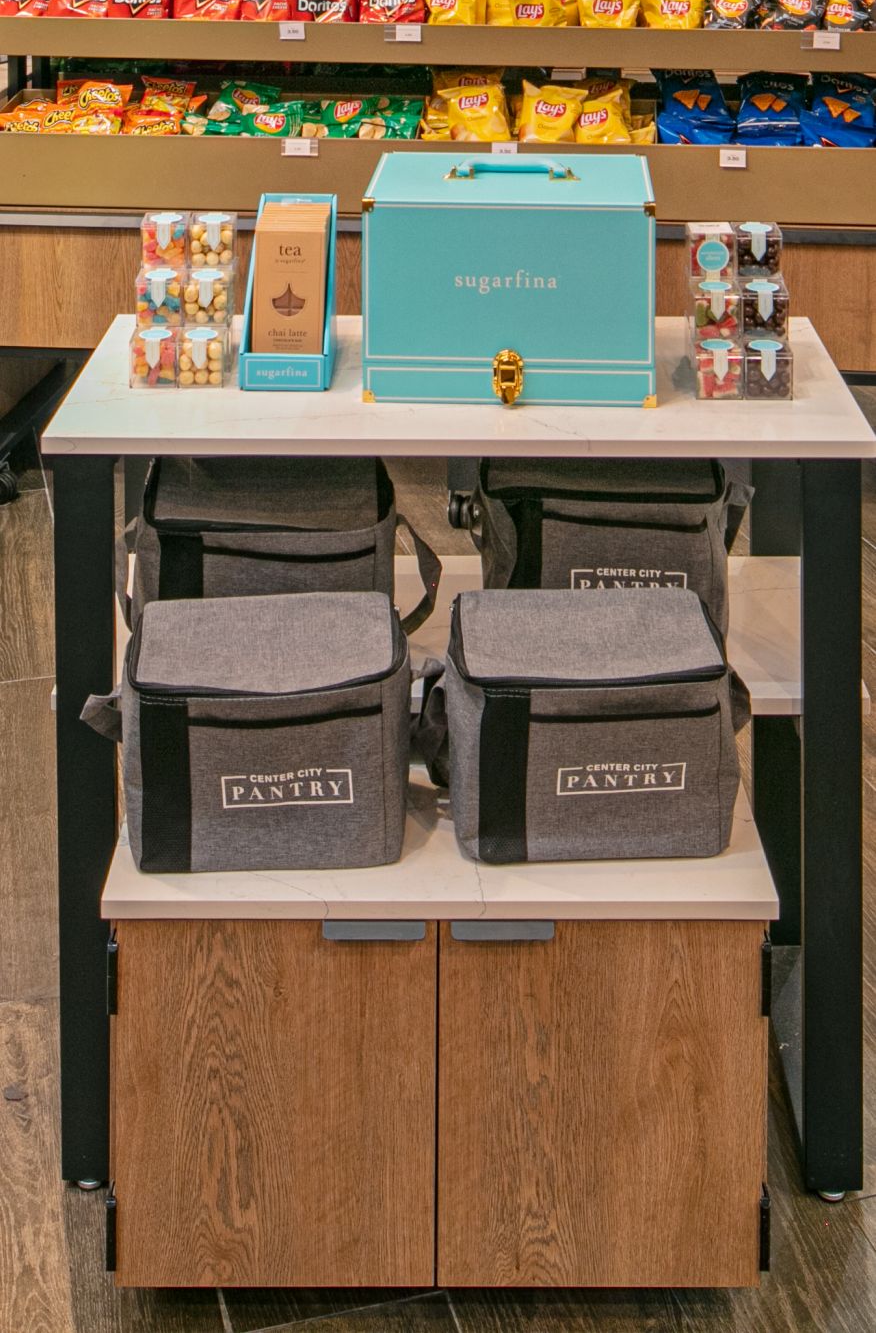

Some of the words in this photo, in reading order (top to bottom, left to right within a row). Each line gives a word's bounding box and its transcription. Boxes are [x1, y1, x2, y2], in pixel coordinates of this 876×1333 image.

[517, 4, 543, 20] Lay's
[662, 0, 690, 15] Lay's
[717, 0, 746, 11] Lay's
[79, 87, 122, 109] Cheetos
[460, 93, 488, 110] Lay's
[335, 100, 362, 116] Lay's
[536, 99, 566, 117] Lay's
[44, 111, 74, 127] Chee
[579, 109, 608, 126] Lay's
[279, 243, 302, 257] tea
[454, 270, 558, 294] sugarfina
[268, 328, 287, 338] chai
[289, 328, 308, 338] latte
[256, 366, 308, 379] sugarfina
[596, 568, 636, 577] CENTER
[639, 569, 662, 578] CITY
[249, 772, 294, 784] CENTER
[297, 767, 322, 778] CITY
[586, 763, 630, 772] CENTER
[633, 763, 659, 772] CITY
[567, 770, 676, 788] PANTRY
[231, 780, 343, 801] PANTRY
